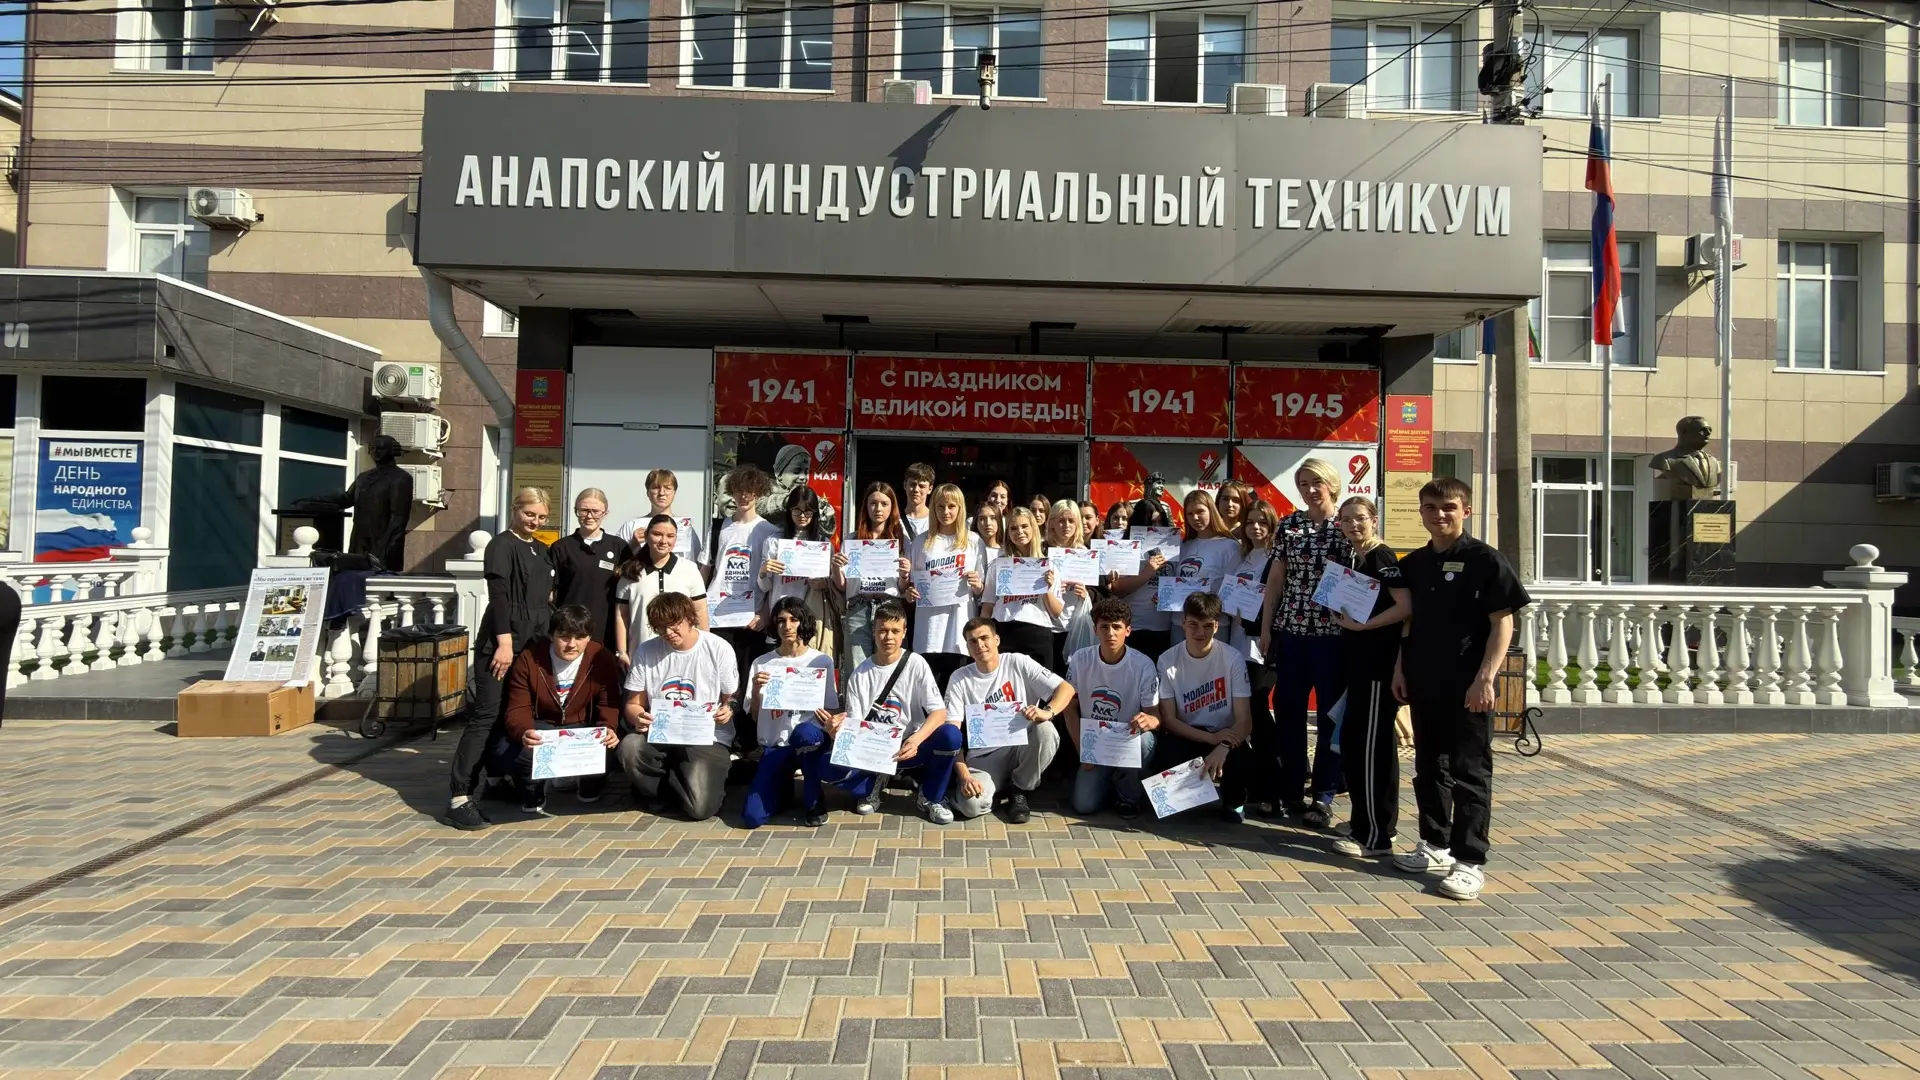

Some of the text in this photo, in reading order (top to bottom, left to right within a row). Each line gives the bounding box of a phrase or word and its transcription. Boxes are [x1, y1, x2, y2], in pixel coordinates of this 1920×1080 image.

[455, 151, 1511, 236] АНАПСКИЙ ИНДУСТРИАЛЬНЫЙ ТЕХНИКУМ
[880, 370, 1061, 392] С ПРАЗДНИКОМ
[748, 378, 815, 404] 1941
[861, 396, 1079, 422] ВЕЛИКОЙ ПОБЕДЫ!
[1128, 388, 1195, 414] 1941
[1271, 392, 1344, 418] 1945
[54, 465, 101, 482] ДЕНЬ
[813, 472, 838, 480] МАЯ
[53, 485, 127, 496] НАРОДНОГО
[1198, 481, 1220, 490] МАЯ
[1348, 485, 1371, 494] МАЯ
[72, 498, 133, 510] ЕДИНСТВА
